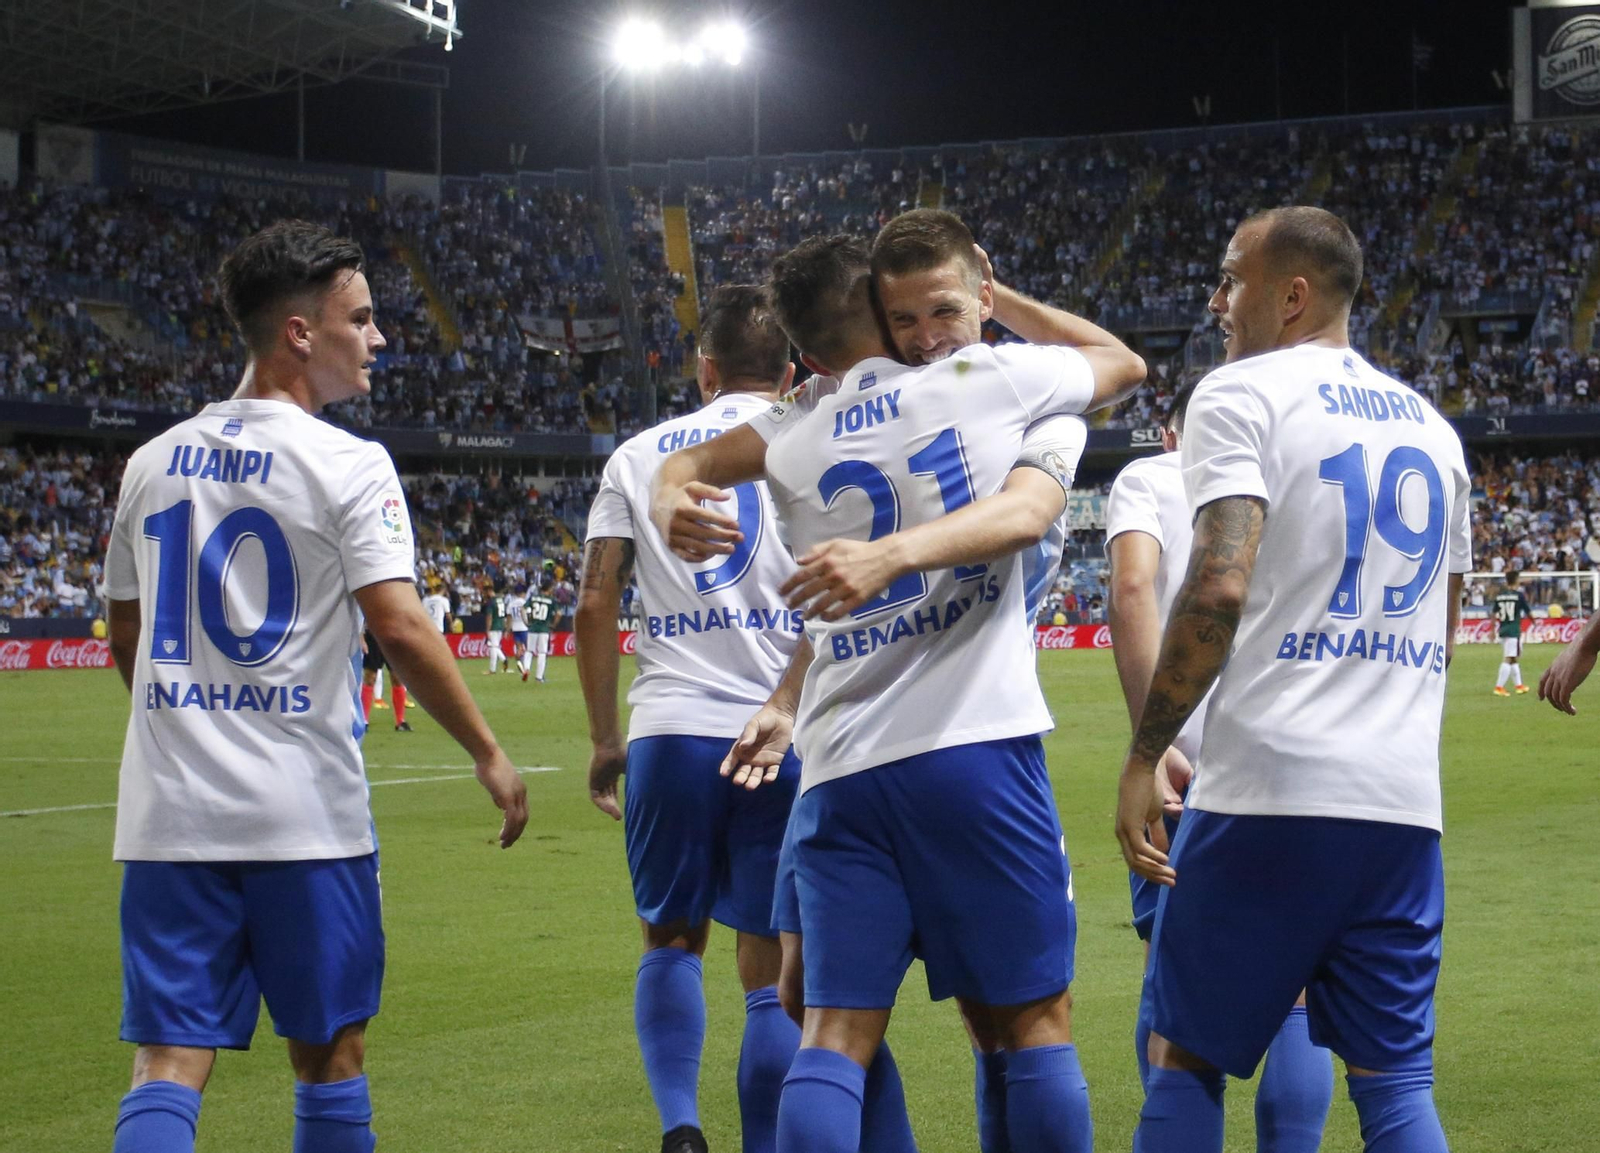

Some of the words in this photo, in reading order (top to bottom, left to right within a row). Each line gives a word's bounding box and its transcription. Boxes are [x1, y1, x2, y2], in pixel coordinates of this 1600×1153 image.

[832, 388, 901, 438] JONY
[1317, 383, 1425, 425] SANDRO
[166, 445, 274, 484] JUANPI
[817, 427, 990, 620] 21
[1318, 442, 1450, 620] 19
[143, 499, 300, 668] 10
[532, 602, 548, 621] 20
[648, 606, 805, 638] BENAHAVIS
[1276, 629, 1444, 674] BENAHAVIS
[144, 682, 312, 714] ENAHAVIS
